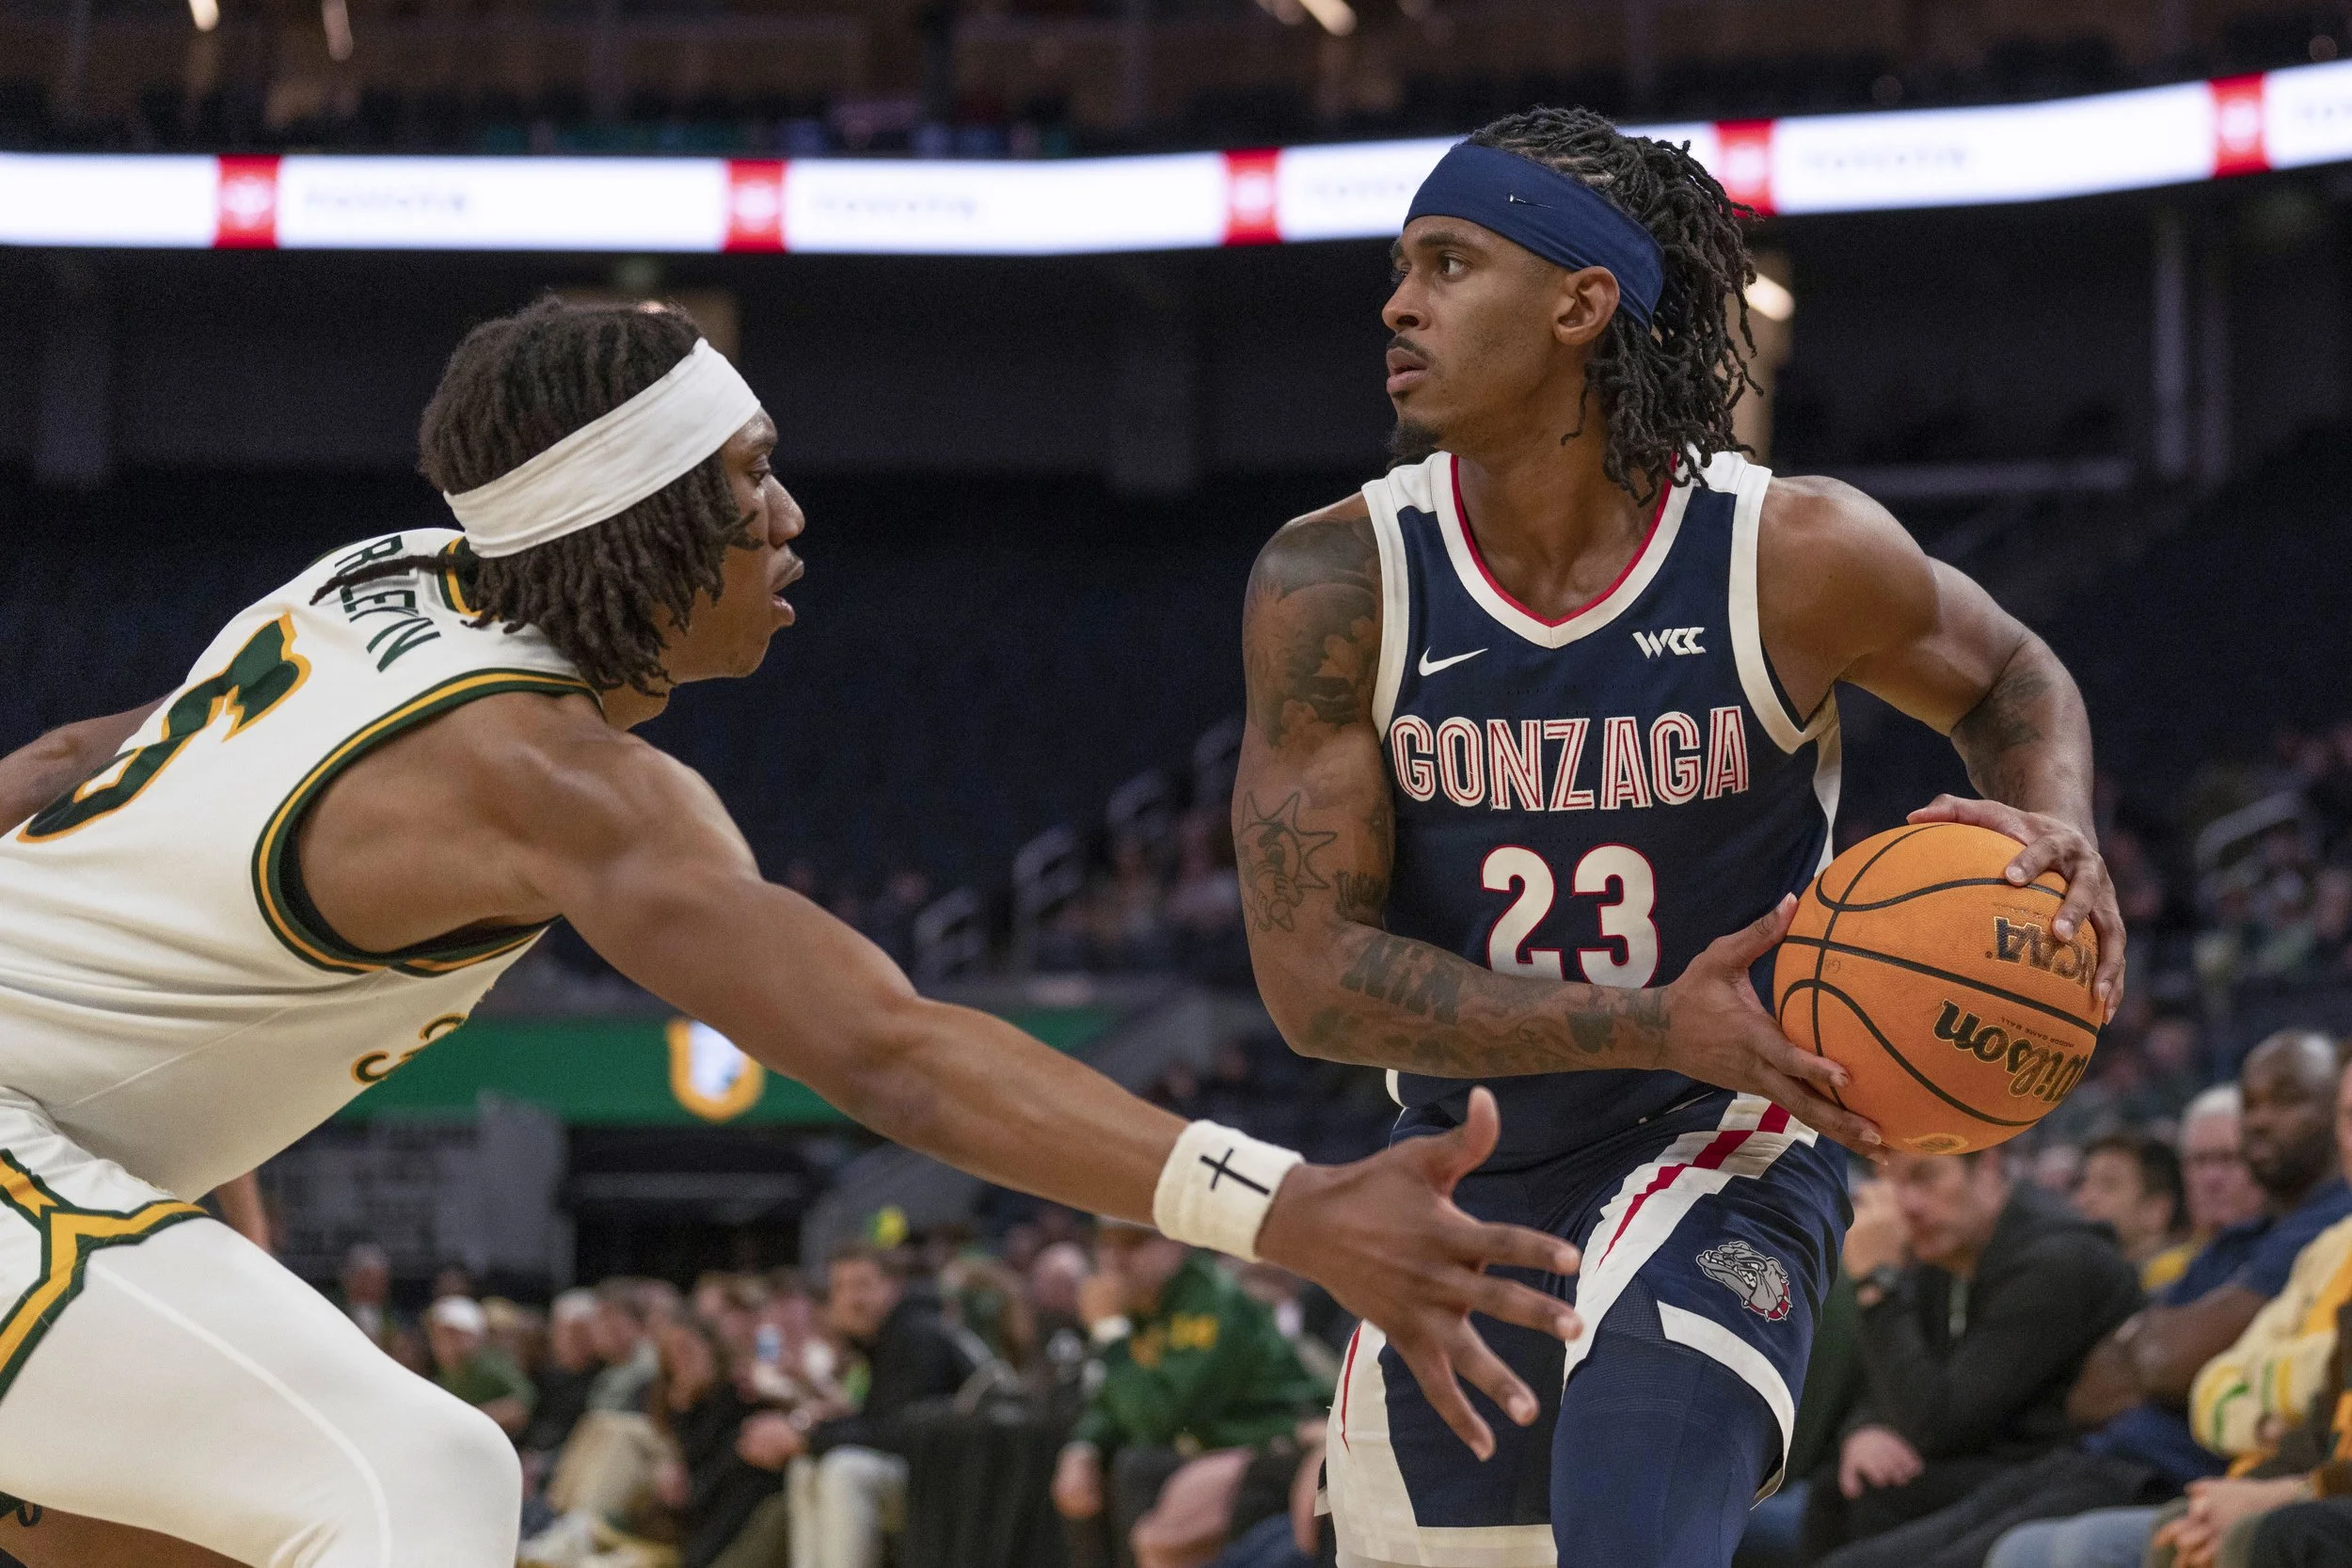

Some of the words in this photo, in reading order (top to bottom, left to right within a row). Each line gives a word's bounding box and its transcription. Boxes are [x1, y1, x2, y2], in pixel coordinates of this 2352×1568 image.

[1632, 626, 1707, 659] WCC
[1390, 705, 1749, 813] GONZAGA
[1480, 843, 1661, 990] 23
[1932, 998, 2089, 1103] Wilson
[2000, 1016, 2023, 1031] BALL
